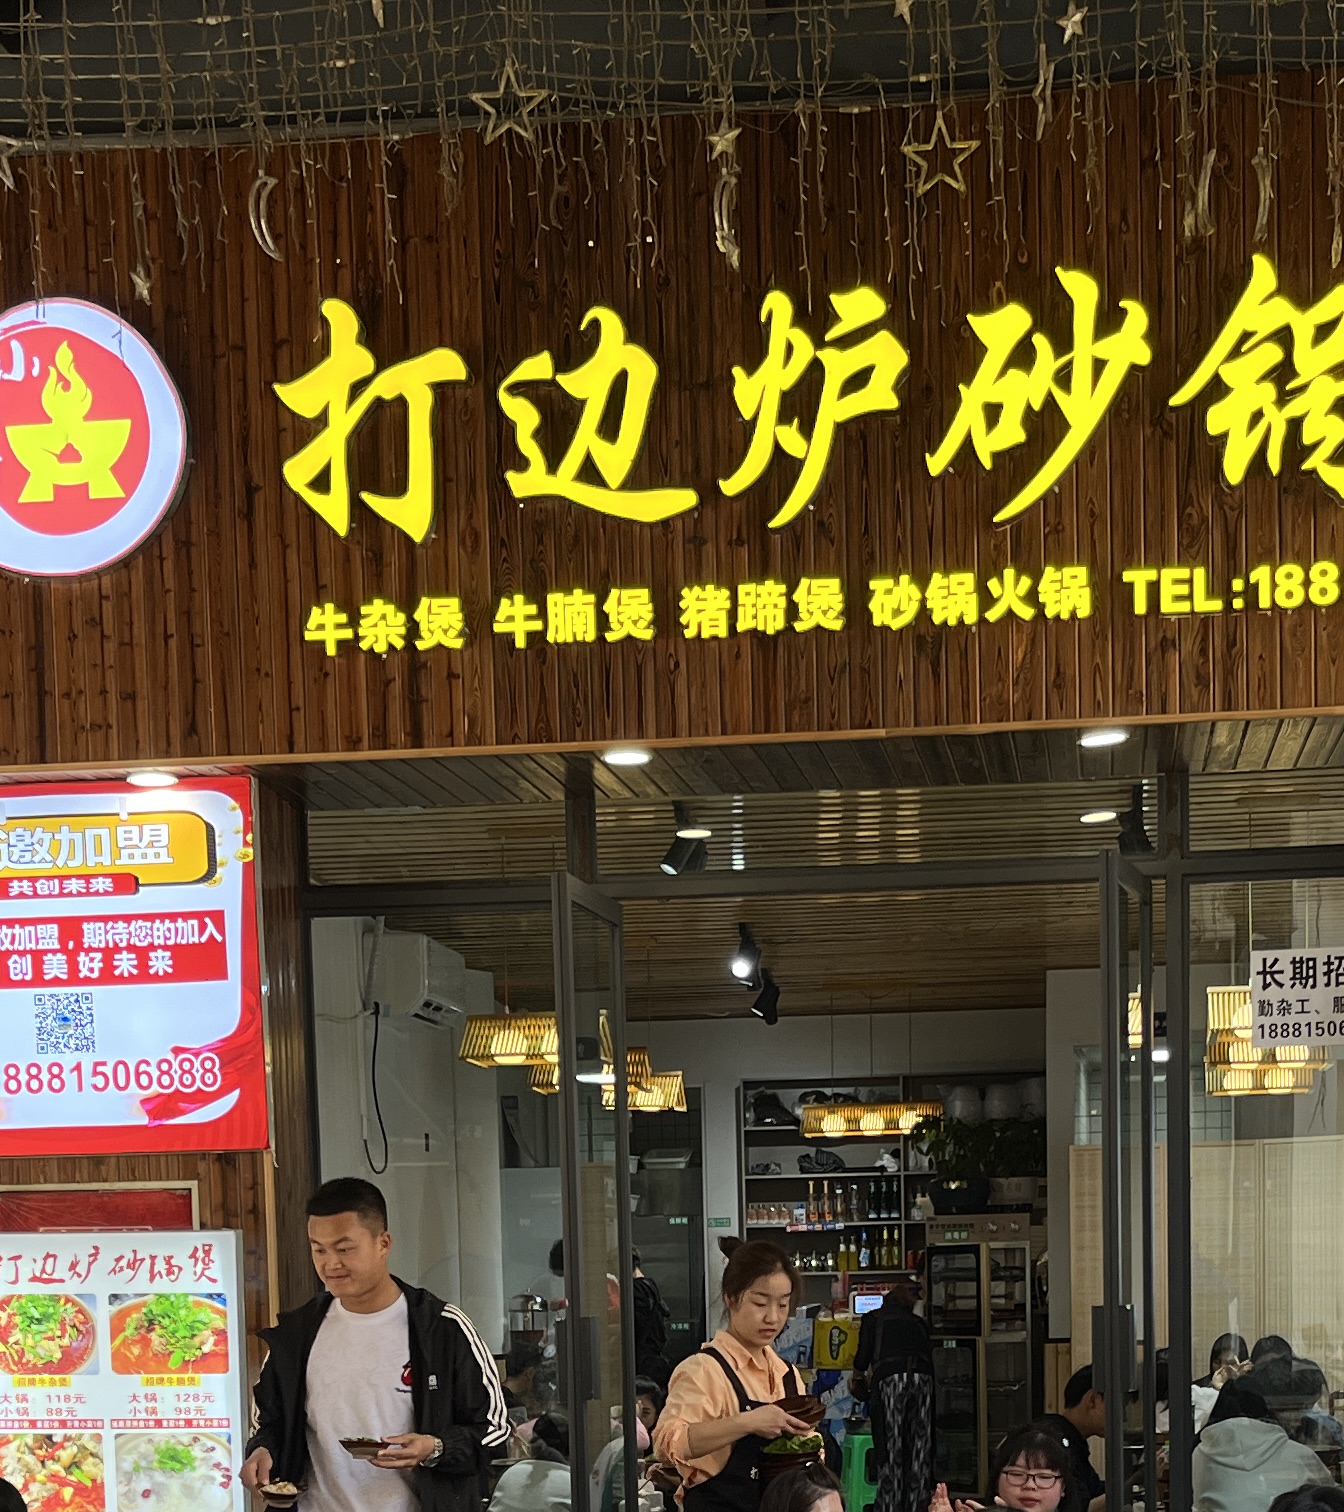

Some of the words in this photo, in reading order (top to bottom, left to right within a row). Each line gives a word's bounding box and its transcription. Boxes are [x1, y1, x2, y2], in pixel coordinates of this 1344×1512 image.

[304, 595, 465, 657] 牛杂煲
[493, 587, 655, 650] 牛腩煲
[678, 575, 846, 641] 猪蹄煲
[867, 564, 1092, 630] 砂锅火锅
[7, 877, 114, 897] 共创未来
